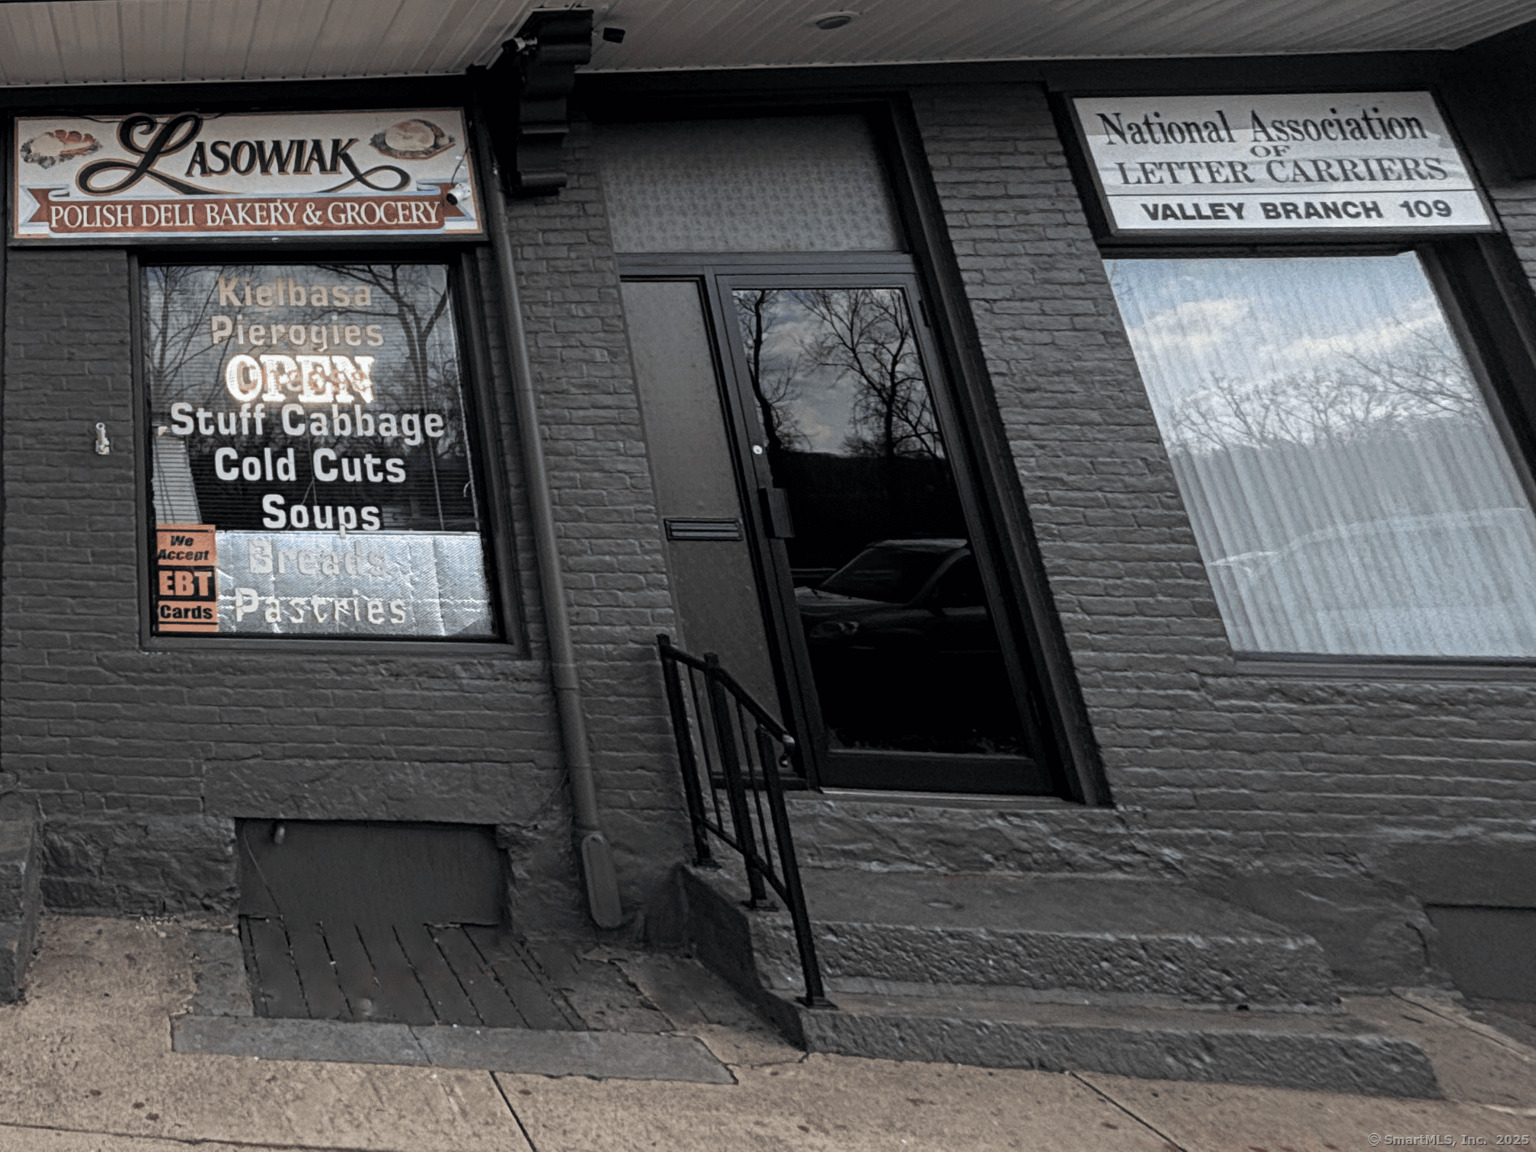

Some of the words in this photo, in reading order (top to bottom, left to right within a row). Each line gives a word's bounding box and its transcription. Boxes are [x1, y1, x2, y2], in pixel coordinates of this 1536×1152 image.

[1096, 109, 1235, 145] National
[1250, 108, 1428, 144] Association
[75, 113, 410, 196] LASOWIAK
[1250, 145, 1291, 158] OF
[1116, 160, 1255, 186] LETTER
[1266, 156, 1449, 184] CARRIERS
[50, 205, 133, 229] POLISH
[140, 204, 195, 228] DELI
[205, 201, 297, 227] BAKERY
[302, 201, 324, 224] &
[327, 200, 440, 225] GROCERY
[1141, 201, 1245, 221] VALLEY
[1263, 200, 1384, 220] BRANCH
[1398, 200, 1453, 219] 109
[218, 277, 373, 307] Kielbasa
[211, 315, 385, 352] Pierogies
[224, 354, 376, 404] OPEN
[170, 402, 266, 436] Stuff
[281, 403, 445, 446] Cabbage
[214, 448, 297, 482] Cold
[314, 448, 407, 483] Cuts
[262, 494, 382, 539] Soups
[157, 549, 210, 562] Accept
[170, 535, 195, 547] We
[248, 537, 387, 578] Breads
[159, 570, 212, 597] EBT
[160, 604, 214, 620] Cards
[235, 588, 408, 625] Pastries
